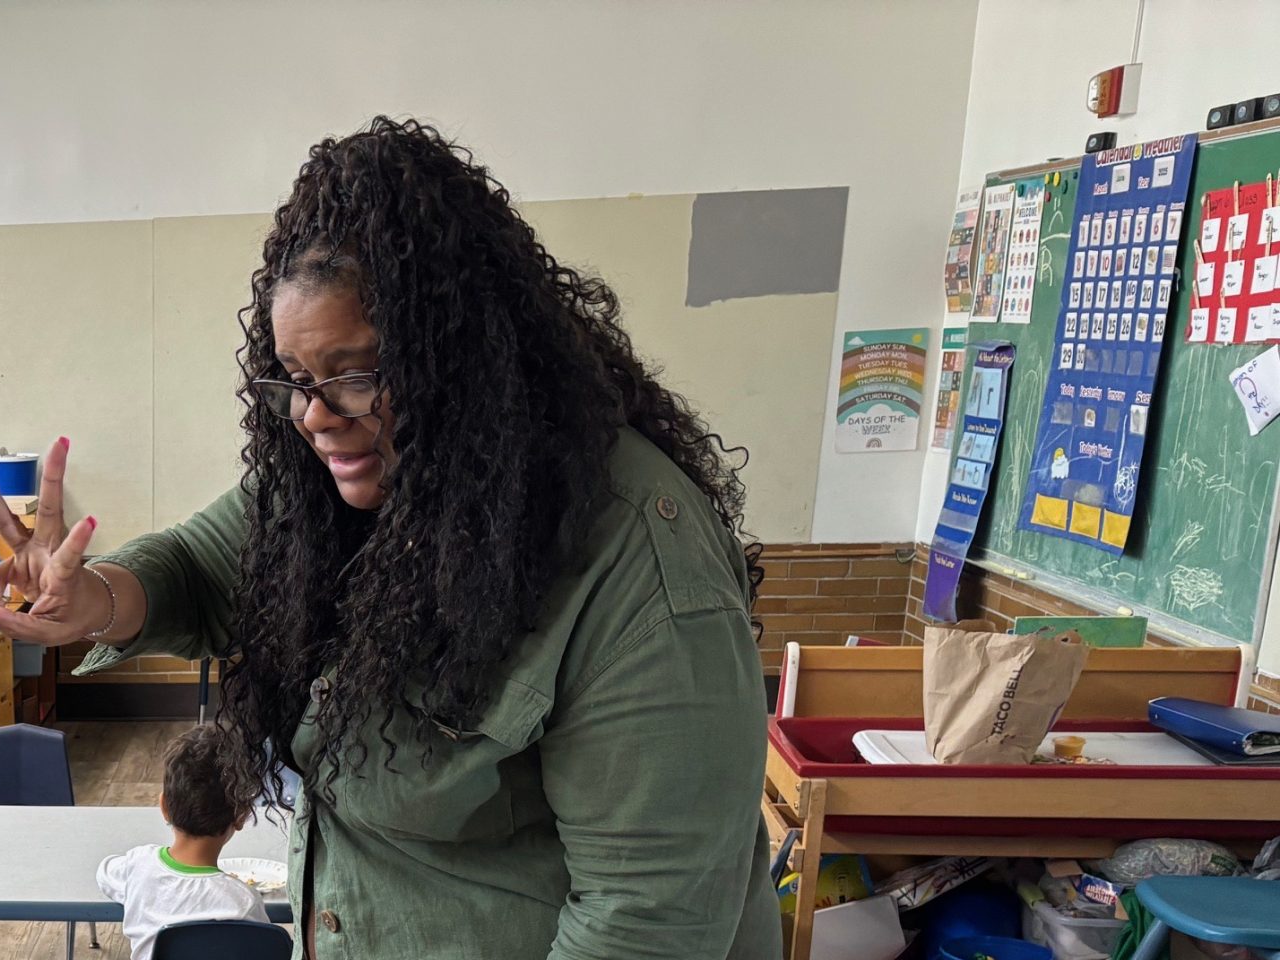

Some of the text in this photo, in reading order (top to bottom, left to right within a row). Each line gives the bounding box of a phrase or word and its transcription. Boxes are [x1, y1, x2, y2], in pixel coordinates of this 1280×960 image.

[1107, 223, 1113, 240] 3
[1136, 221, 1143, 237] 5
[1153, 218, 1159, 235] 6
[1170, 218, 1177, 234] 7
[1132, 253, 1139, 269] 12
[1072, 287, 1079, 302] 15
[1099, 287, 1106, 302] 17
[1142, 286, 1151, 302] 20
[1160, 286, 1168, 301] 21
[1066, 318, 1075, 332] 22
[1093, 318, 1102, 333] 24
[1108, 319, 1116, 334] 25
[1121, 319, 1130, 335] 26
[1154, 320, 1163, 336] 28
[863, 343, 891, 352] SUNDAY
[860, 351, 890, 361] MONDAY
[1062, 349, 1071, 363] 29
[858, 360, 889, 370] TUESDAY
[857, 376, 893, 385] THURSDAY
[856, 393, 892, 403] SATURDAY
[848, 414, 906, 425] DAYS OF THE
[991, 666, 1024, 735] TACO BELL
